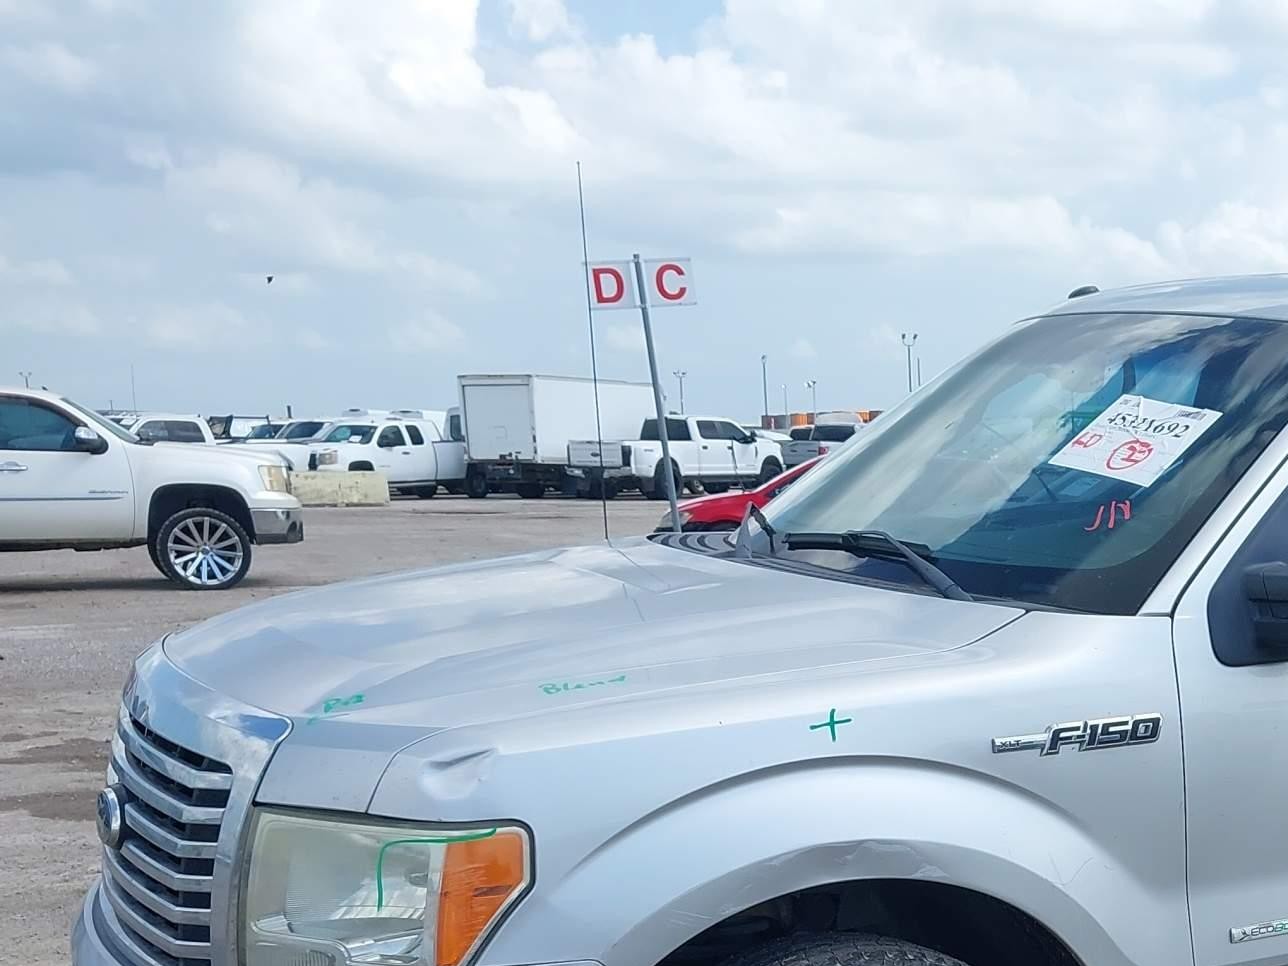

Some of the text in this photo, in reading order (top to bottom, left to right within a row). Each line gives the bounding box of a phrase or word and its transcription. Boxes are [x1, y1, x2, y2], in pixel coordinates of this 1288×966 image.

[591, 267, 625, 304] D
[655, 263, 688, 301] C
[1107, 412, 1190, 438] 45321692
[1000, 740, 1021, 749] XLT
